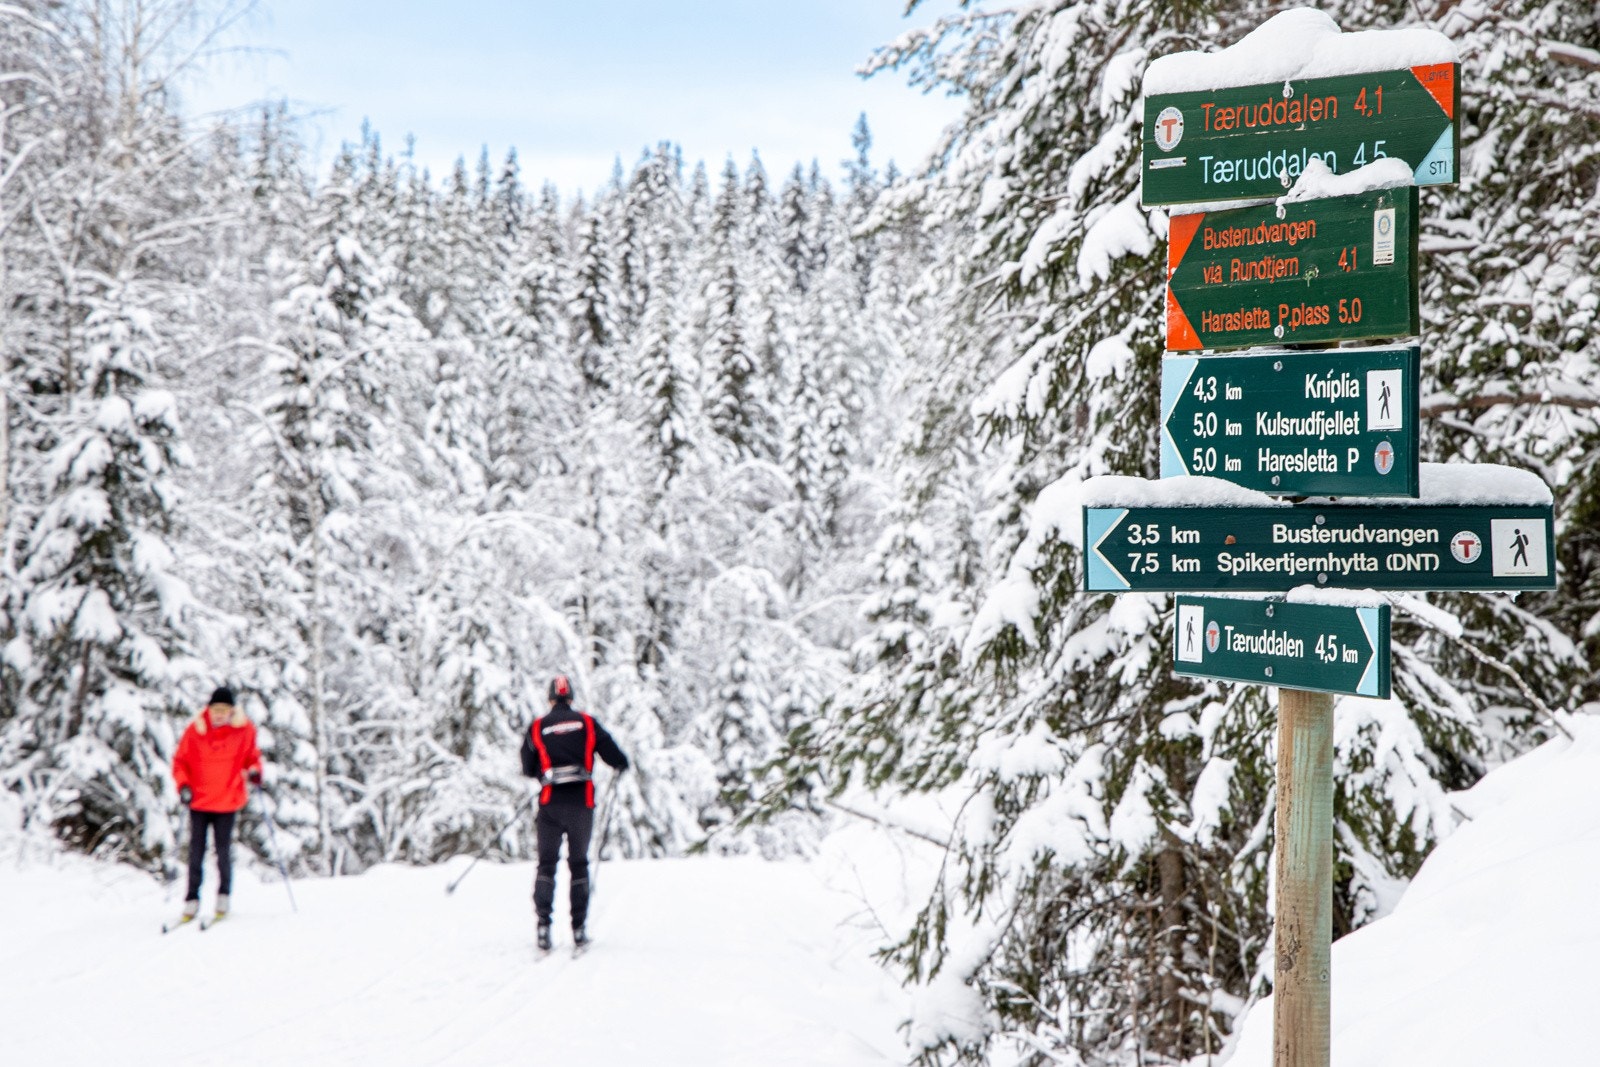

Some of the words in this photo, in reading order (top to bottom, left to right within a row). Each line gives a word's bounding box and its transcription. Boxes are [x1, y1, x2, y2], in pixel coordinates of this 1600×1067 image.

[1201, 93, 1338, 131] Tæruddalen
[1354, 85, 1384, 118] 4,1
[1429, 160, 1448, 176] STI
[1203, 219, 1317, 250] Busterudvangen
[1203, 262, 1223, 284] via
[1230, 254, 1299, 284] Rundtjern
[1202, 307, 1271, 333] Harasletta
[1193, 376, 1217, 403] 4,3
[1225, 383, 1242, 400] km
[1193, 412, 1218, 437] 5,0
[1225, 419, 1242, 436] km
[1256, 411, 1360, 440] Kulsrudfjellet
[1192, 447, 1217, 474] 5,0
[1225, 454, 1242, 472] km
[1258, 447, 1338, 473] Haresletta
[1347, 448, 1359, 473] P
[1127, 524, 1160, 546] 3,5
[1171, 525, 1200, 544] km
[1272, 523, 1439, 547] Busterudvangen
[1127, 552, 1160, 575] 7,5
[1171, 554, 1201, 572] km
[1217, 552, 1378, 576] Spikertjernhytta
[1386, 553, 1440, 571] (DNT)
[1224, 625, 1304, 658] Tæruddalen
[1315, 634, 1338, 664] 4,5
[1342, 644, 1358, 664] km
